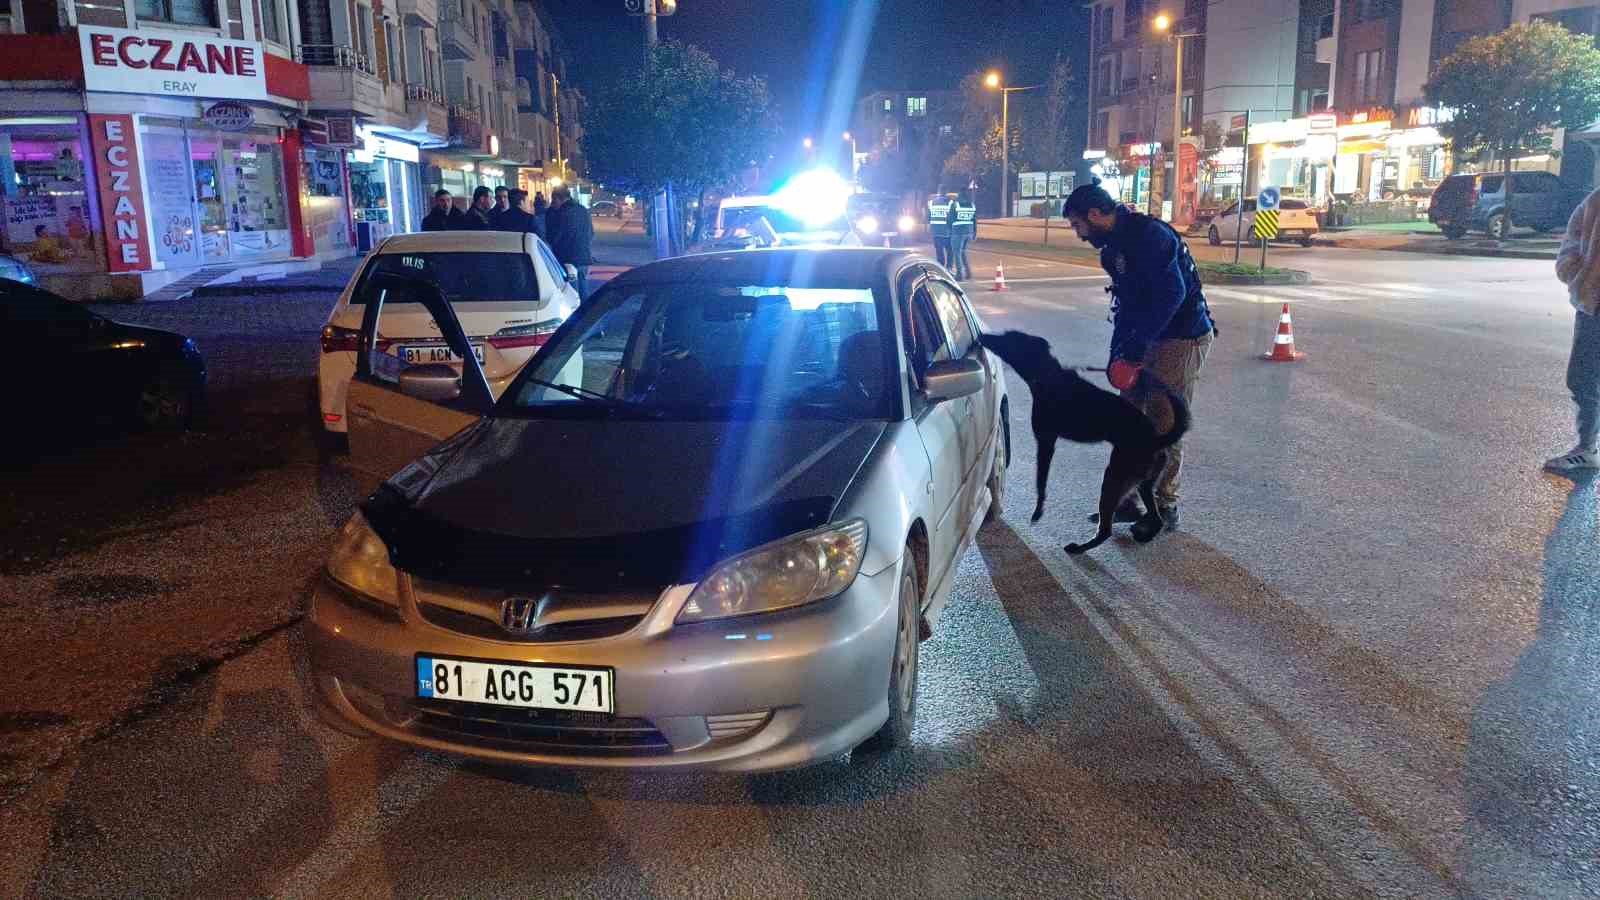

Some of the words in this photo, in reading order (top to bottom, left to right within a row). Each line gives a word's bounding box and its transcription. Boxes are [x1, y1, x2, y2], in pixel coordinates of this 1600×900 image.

[90, 33, 257, 77] ECZANE
[163, 80, 198, 93] ERAY
[105, 120, 140, 264] ECZANE
[419, 679, 433, 690] TR
[434, 663, 464, 697] 81
[485, 667, 534, 702] ACG
[553, 671, 604, 707] 571
